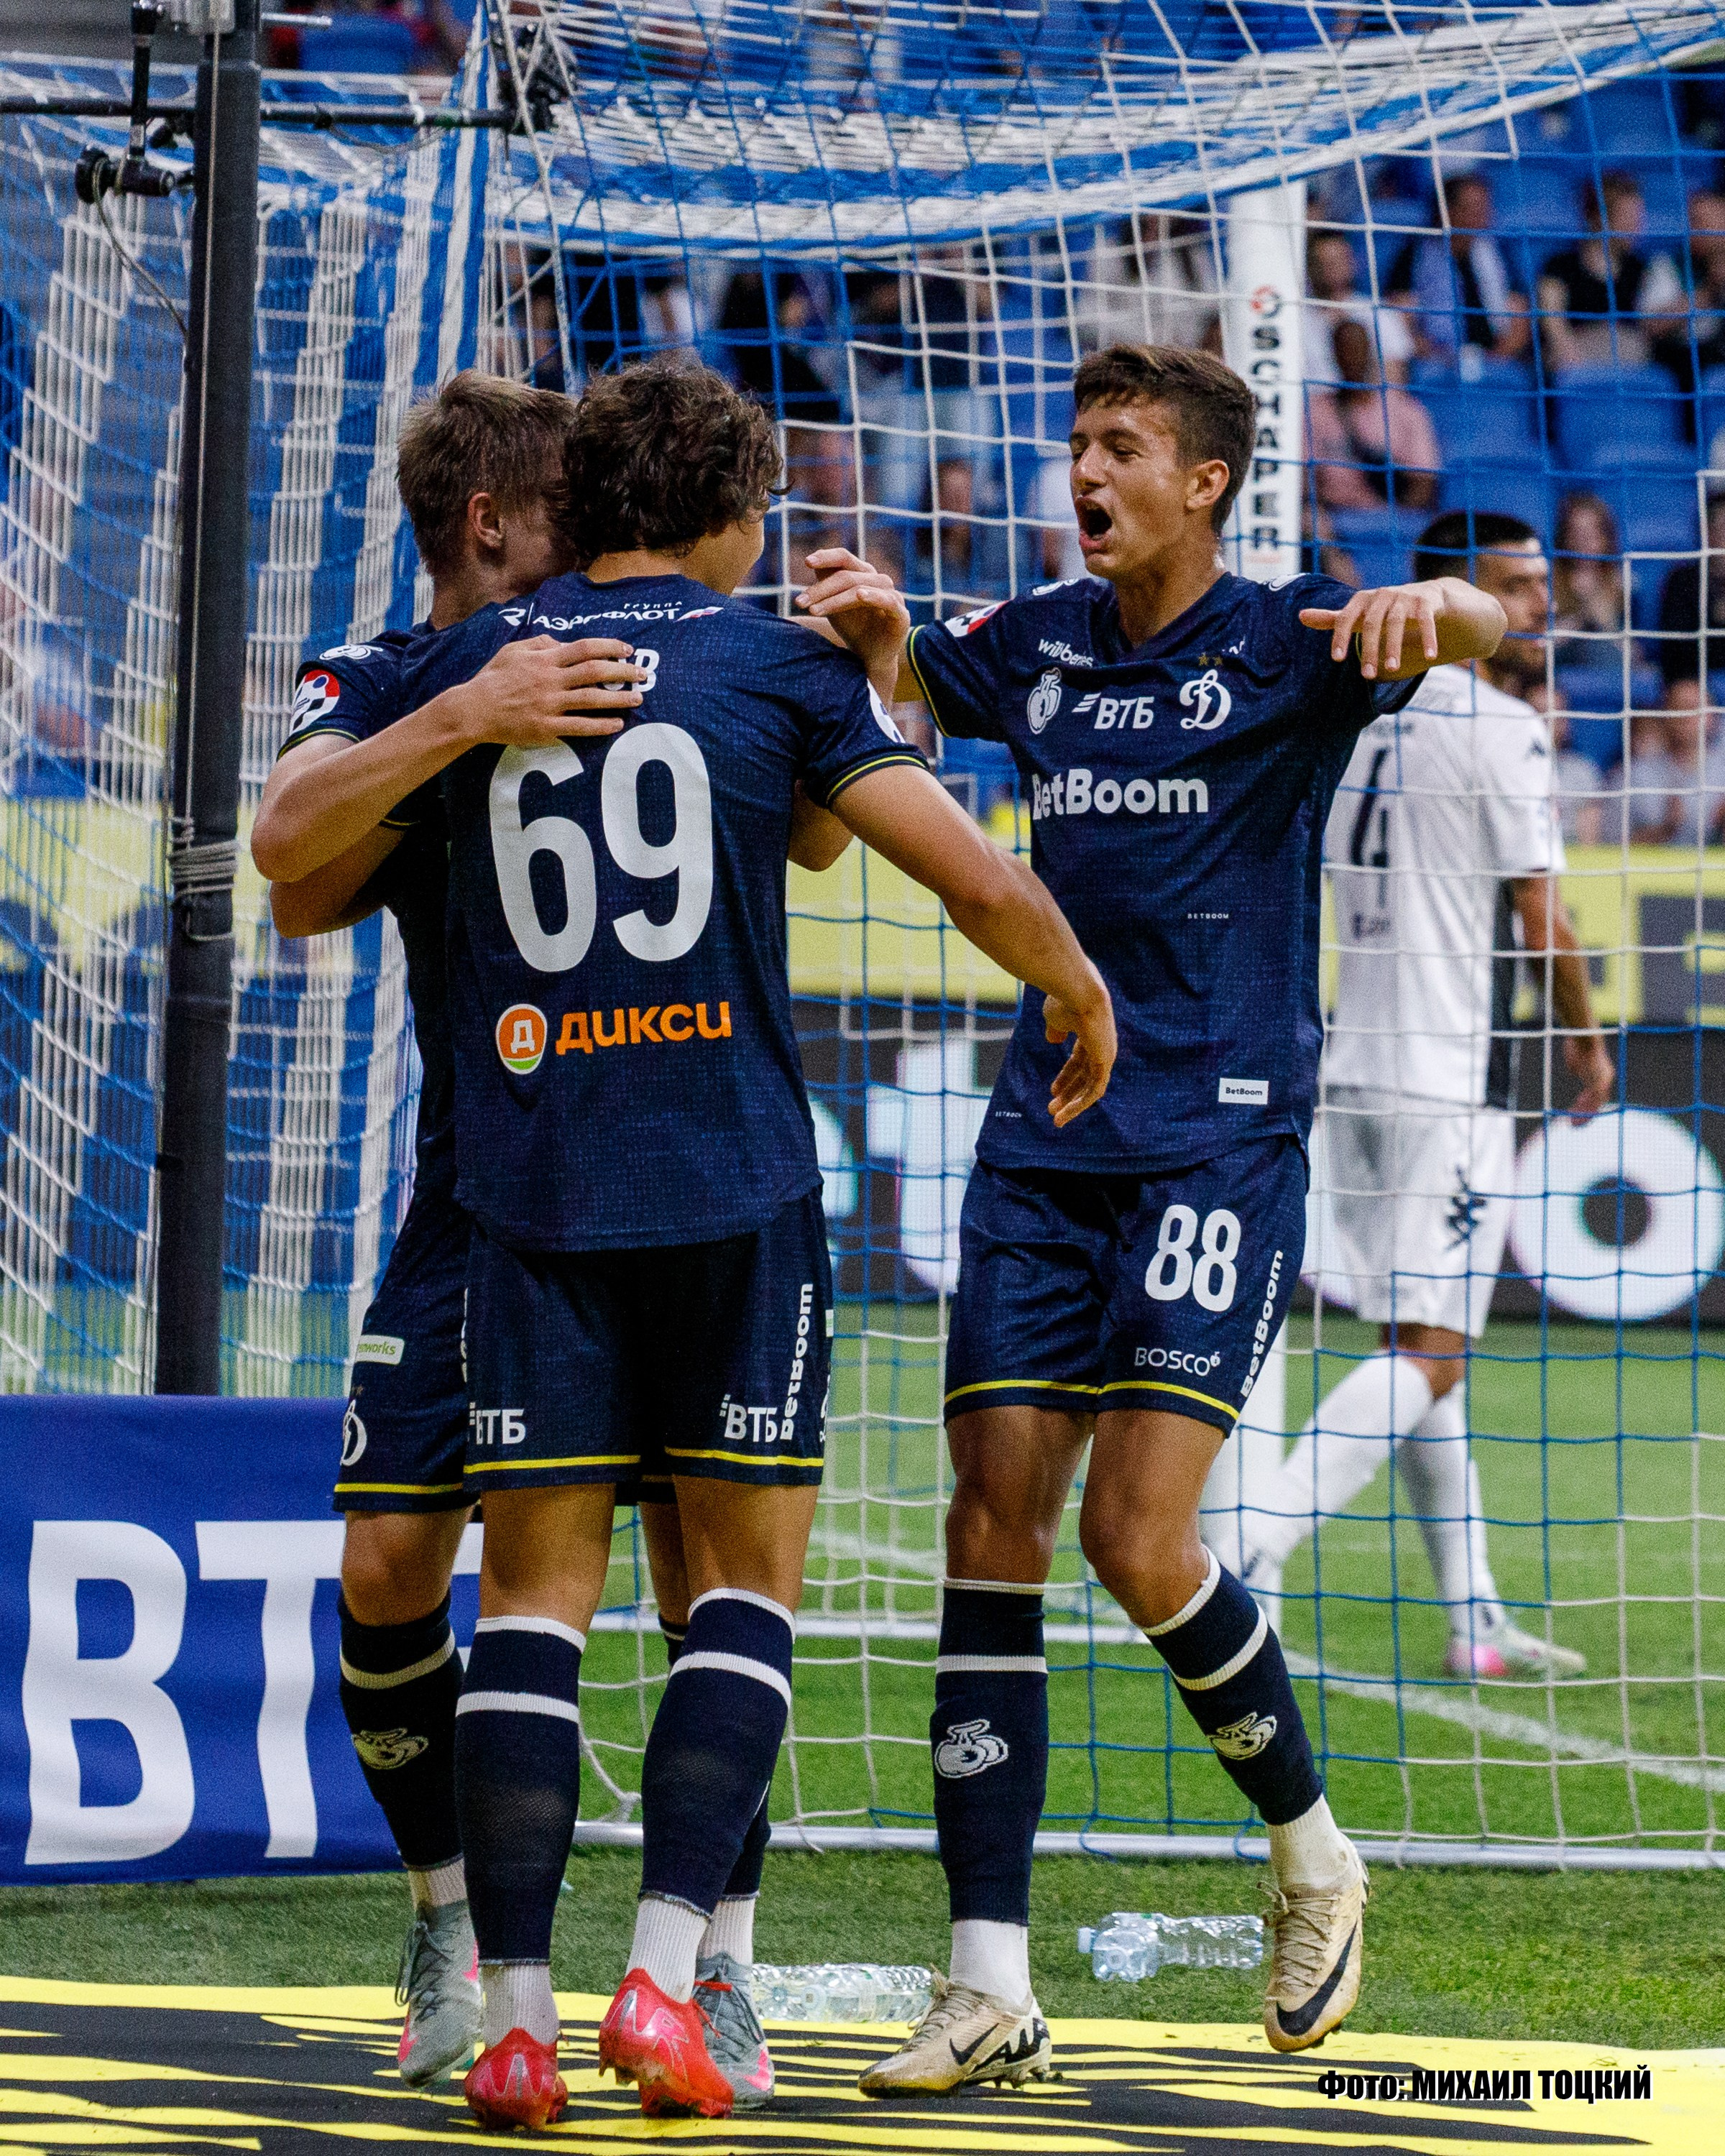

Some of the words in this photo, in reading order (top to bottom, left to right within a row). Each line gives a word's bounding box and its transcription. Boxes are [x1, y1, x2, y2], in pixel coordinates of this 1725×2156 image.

[1094, 696, 1155, 729] ВТБ
[1031, 768, 1209, 821] BetBoom
[489, 722, 714, 972] 69
[1225, 1087, 1263, 1097] BetBoom
[1144, 1204, 1242, 1312] 88
[1240, 1250, 1284, 1398] BetBoom
[1134, 1348, 1211, 1377] BOSCO
[724, 1403, 778, 1442] ВТБ
[22, 1519, 484, 1865] ВТ
